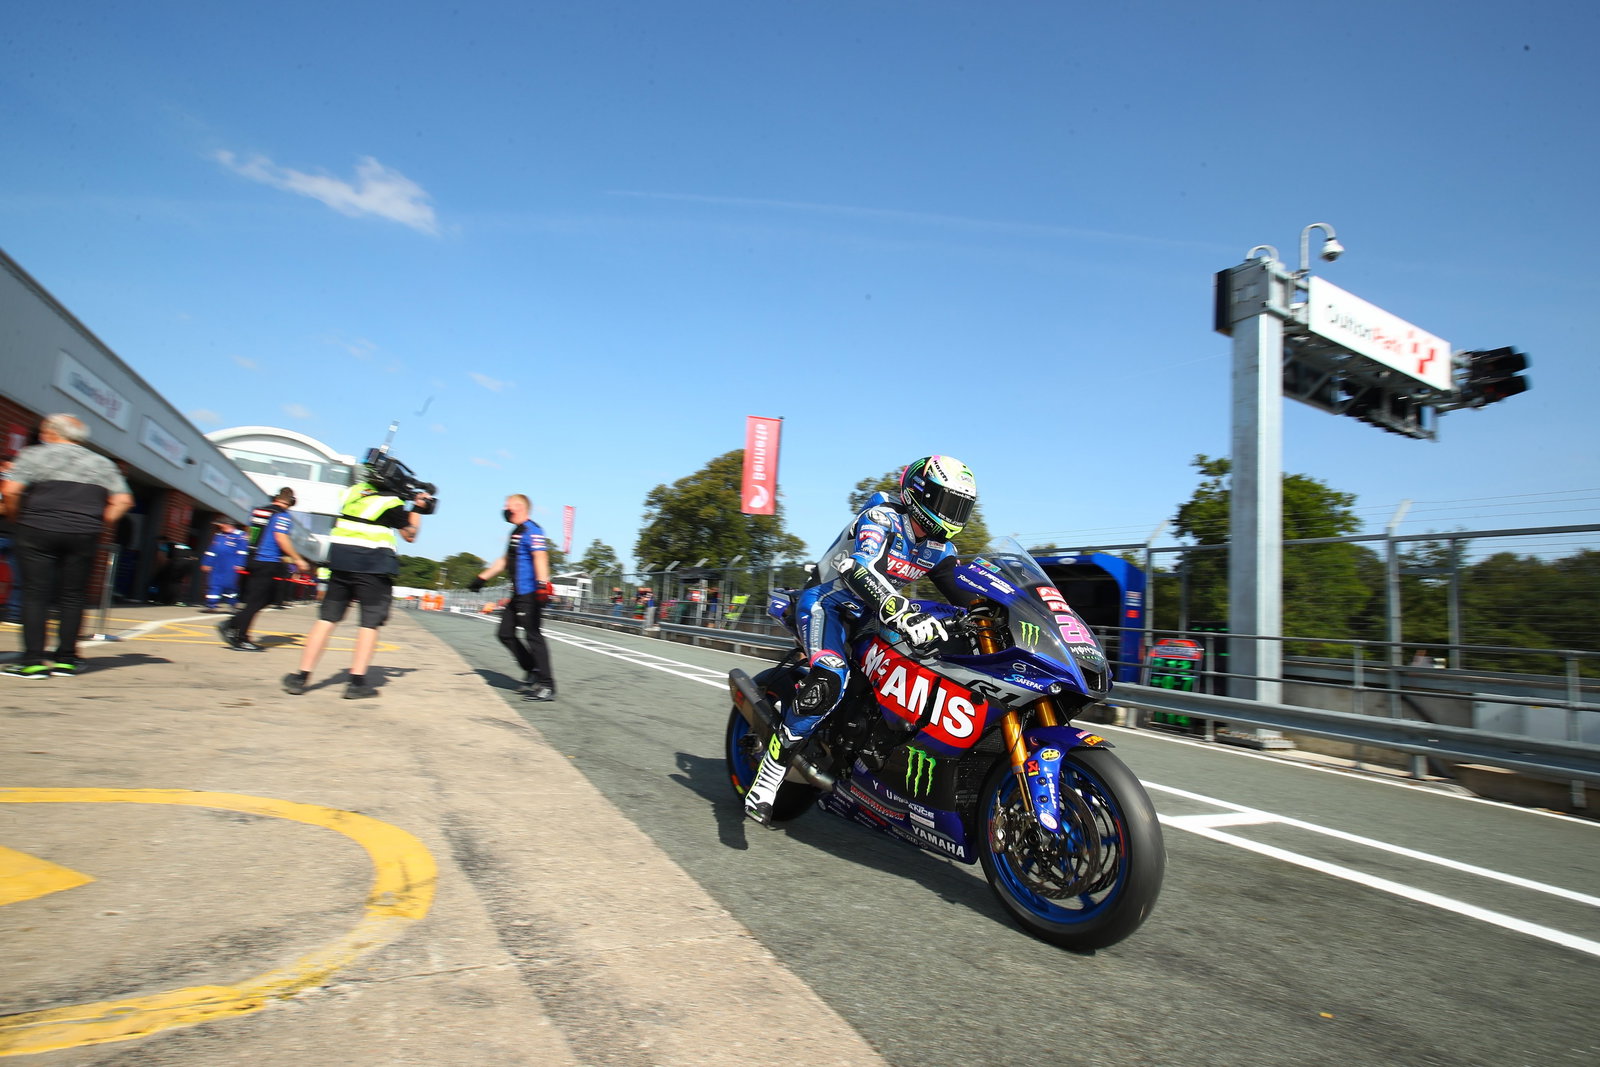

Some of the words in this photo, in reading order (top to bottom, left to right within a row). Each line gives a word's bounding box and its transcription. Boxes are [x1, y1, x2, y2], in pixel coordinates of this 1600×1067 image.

[861, 642, 976, 738] McAMS
[1015, 676, 1045, 691] SAFEPAC
[911, 824, 966, 858] YAMAHA
